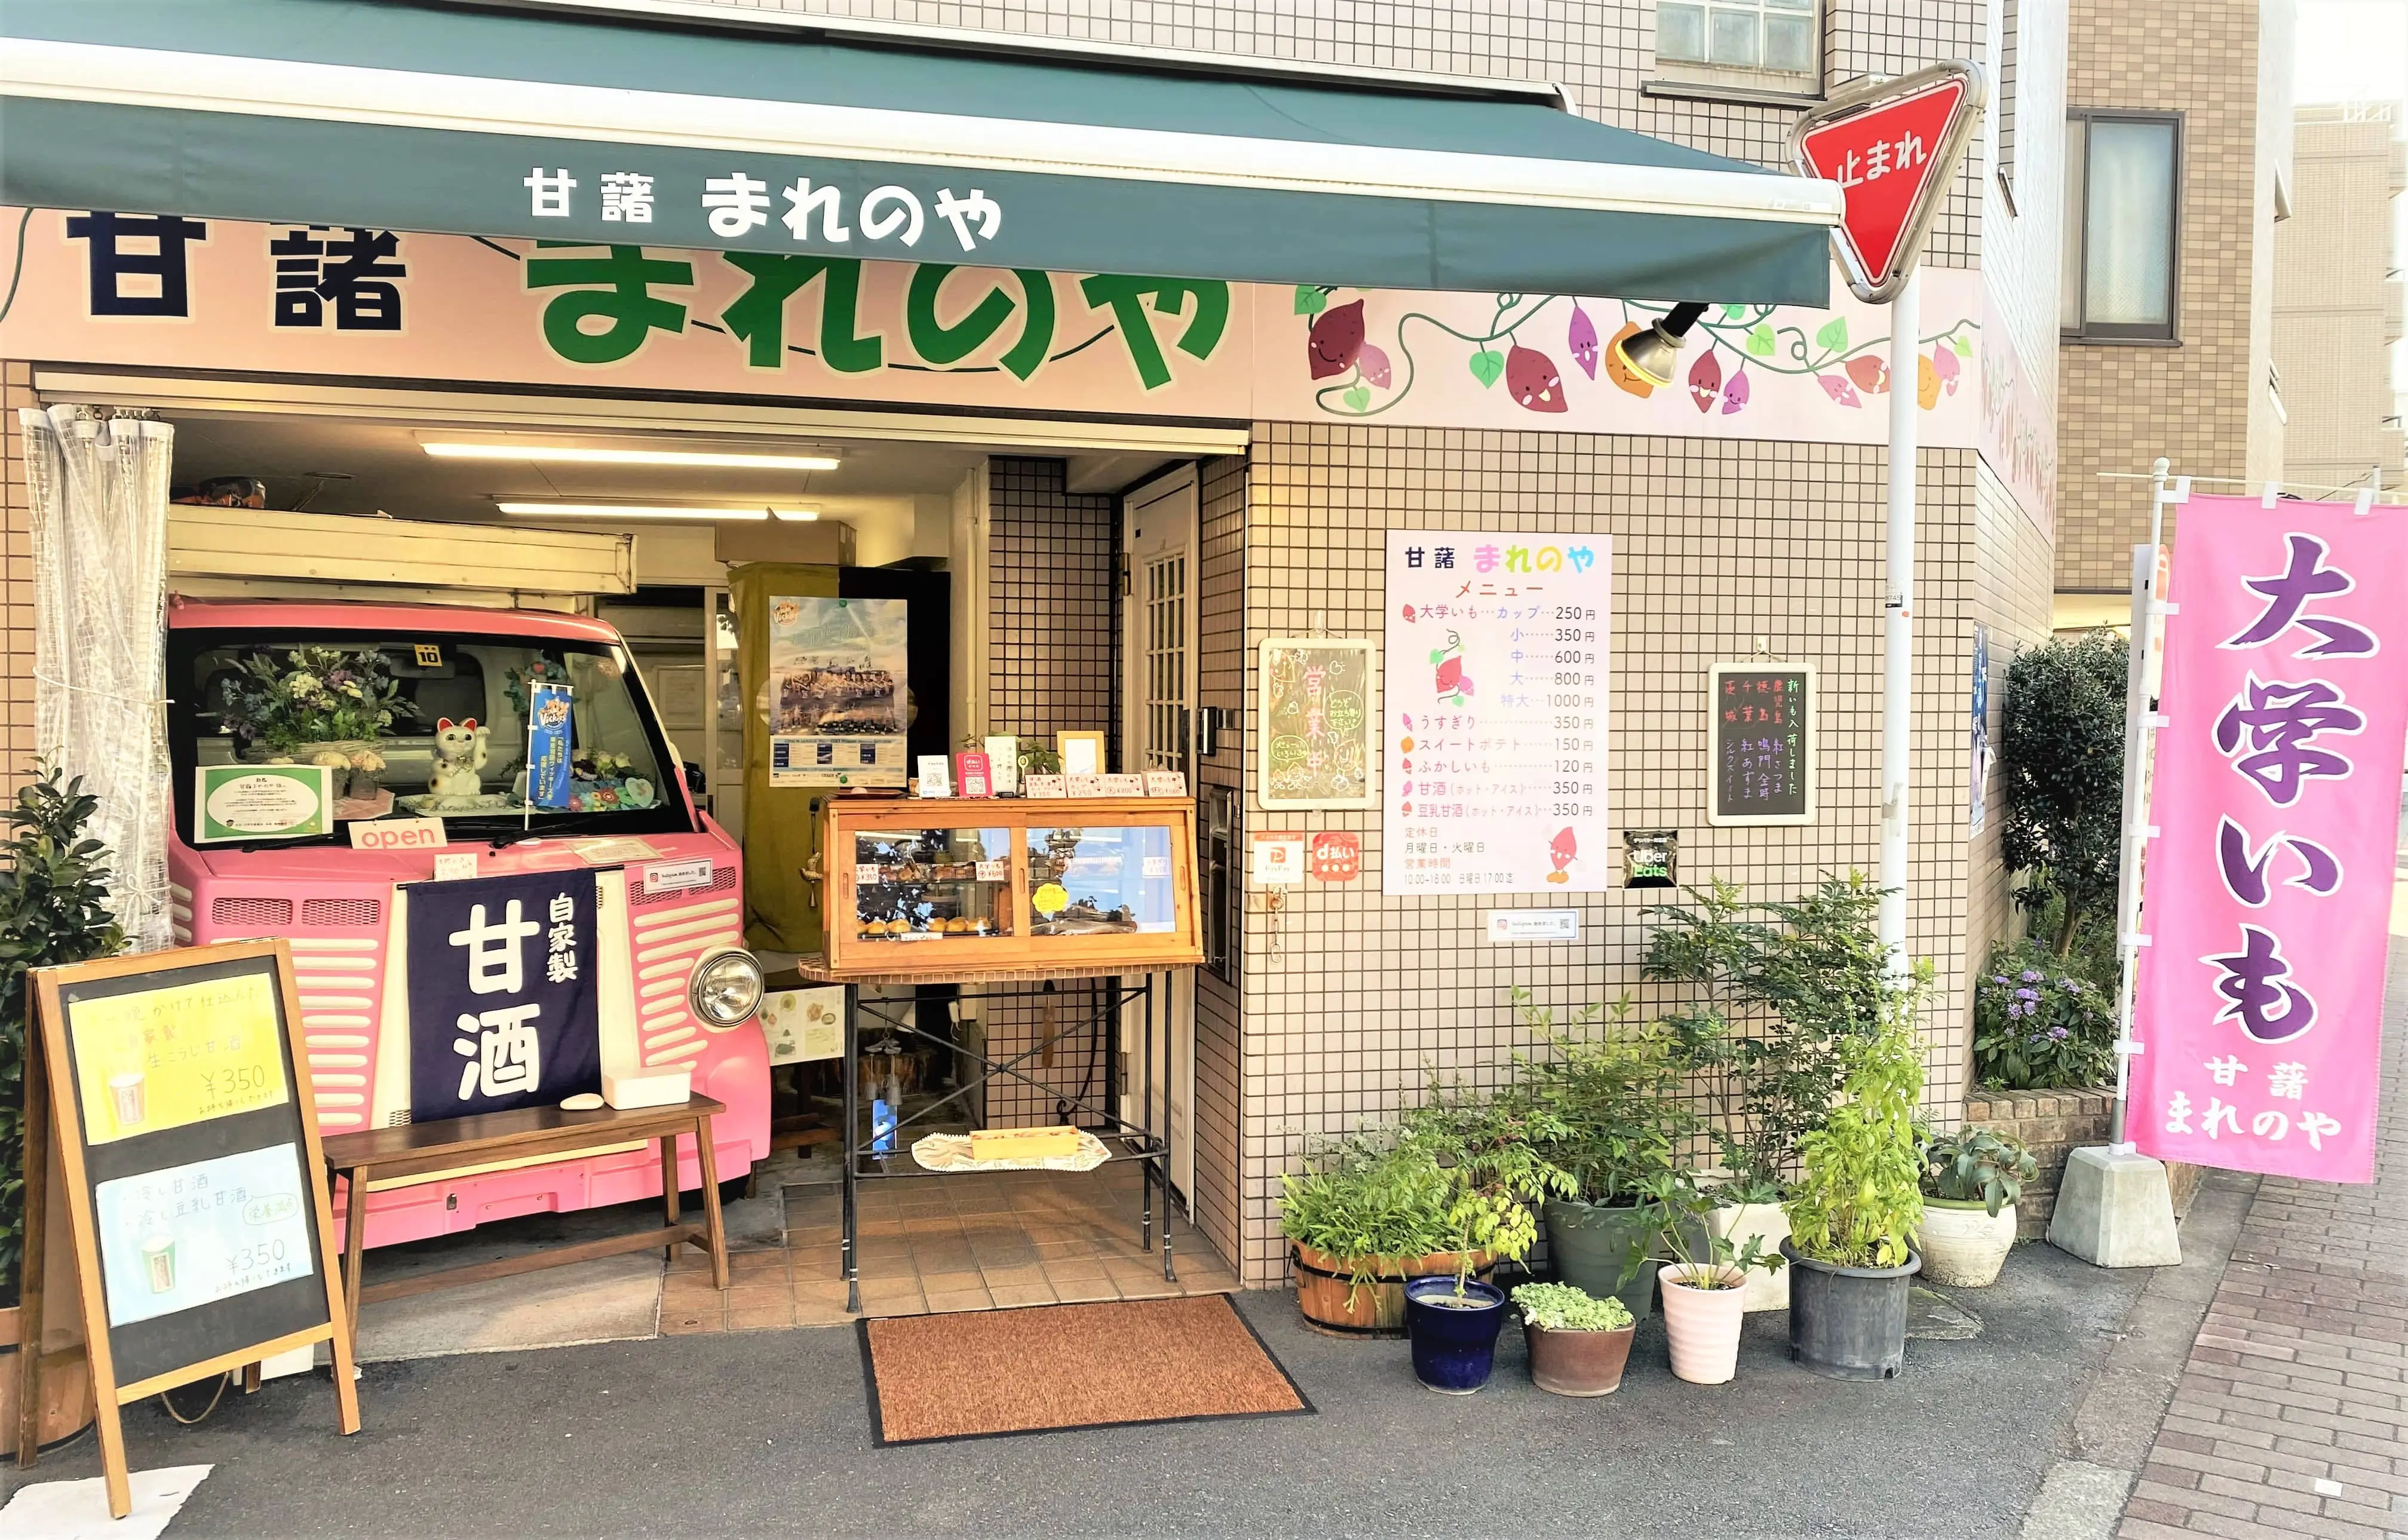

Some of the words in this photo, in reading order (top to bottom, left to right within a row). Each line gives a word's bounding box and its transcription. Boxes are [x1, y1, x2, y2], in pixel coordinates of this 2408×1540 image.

[1837, 130, 1928, 189] 止まれ
[701, 172, 1002, 252] まれのや
[527, 240, 1230, 391] まれのや
[1473, 544, 1594, 573] まれのや
[1455, 580, 1543, 598] メニュー
[1419, 604, 1477, 619] 大学いも
[1496, 605, 1541, 619] カップ
[1556, 606, 1596, 621] 250円
[1510, 627, 1524, 642] 小
[1554, 628, 1595, 643] 350円
[1510, 649, 1524, 663] 中
[1554, 651, 1594, 664] 600円
[1510, 671, 1524, 685] 大
[1554, 672, 1594, 686] 800円
[1500, 694, 1529, 708] 特大
[1421, 715, 1476, 730] うすぎり
[1553, 716, 1593, 730] 350円
[1418, 738, 1522, 751] スイートポテト
[1554, 738, 1593, 751] 150円
[1787, 679, 1800, 796] 新いも入荷しました
[1418, 759, 1491, 774] ふかしいも
[1554, 759, 1593, 773] 120円
[1553, 781, 1593, 795] 350円
[2203, 532, 2380, 1044] 大学いも
[1553, 803, 1593, 817] 350円
[361, 827, 436, 849] open
[1404, 827, 1438, 838] 定休日
[1317, 843, 1354, 860] d払い
[1633, 849, 1668, 863] Uber
[1404, 857, 1451, 869] 営業時間
[1634, 864, 1668, 878] Eats
[546, 892, 578, 983] 自家製
[449, 898, 541, 1101] 甘酒
[200, 1064, 265, 1101] ¥350
[2165, 1091, 2342, 1152] まれのや
[225, 1238, 285, 1277] ¥350
